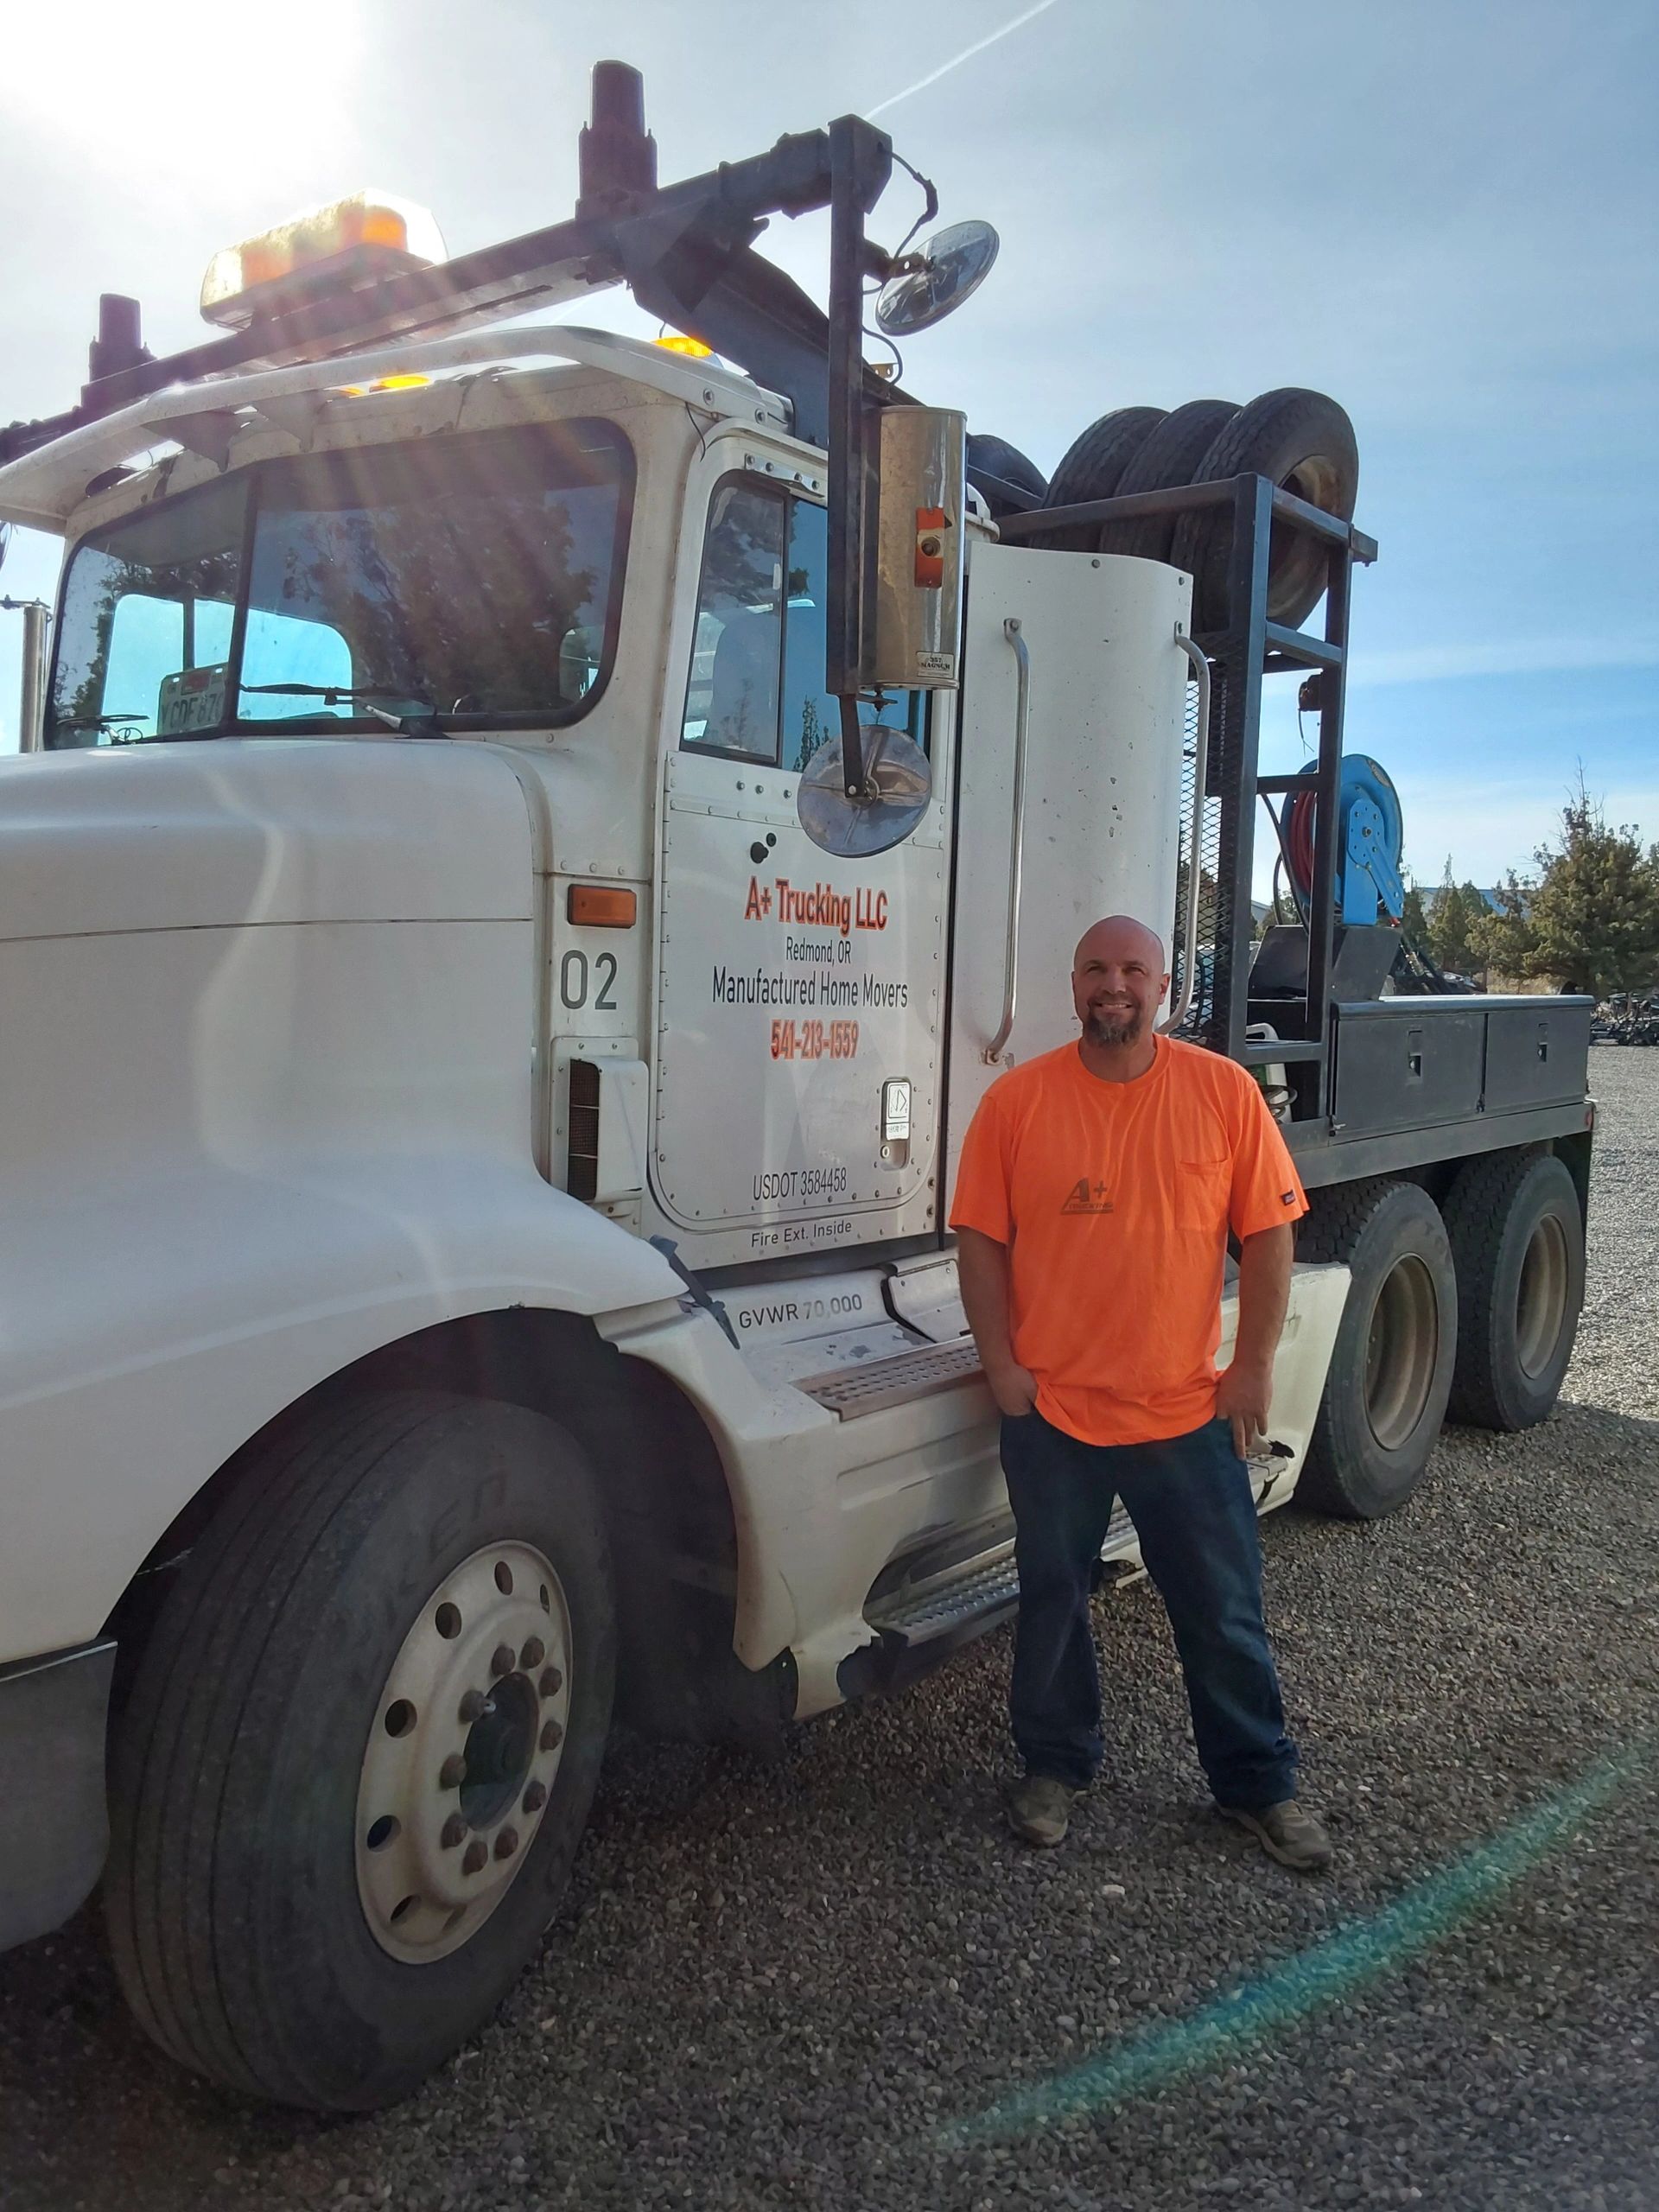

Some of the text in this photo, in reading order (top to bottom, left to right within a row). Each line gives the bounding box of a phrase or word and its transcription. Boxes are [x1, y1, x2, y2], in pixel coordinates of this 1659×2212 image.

[744, 875, 888, 937] A+ Trucking LLC
[786, 936, 852, 967] Redmond, OR
[560, 949, 618, 1011] 02
[712, 965, 908, 1008] Manufactured Home Movers
[770, 1019, 860, 1061] 541-213-1559
[753, 1166, 847, 1200] USDOT 3584458
[751, 1219, 853, 1248] Fire Ext. Inside
[739, 1294, 863, 1329] GVWR 70,000
